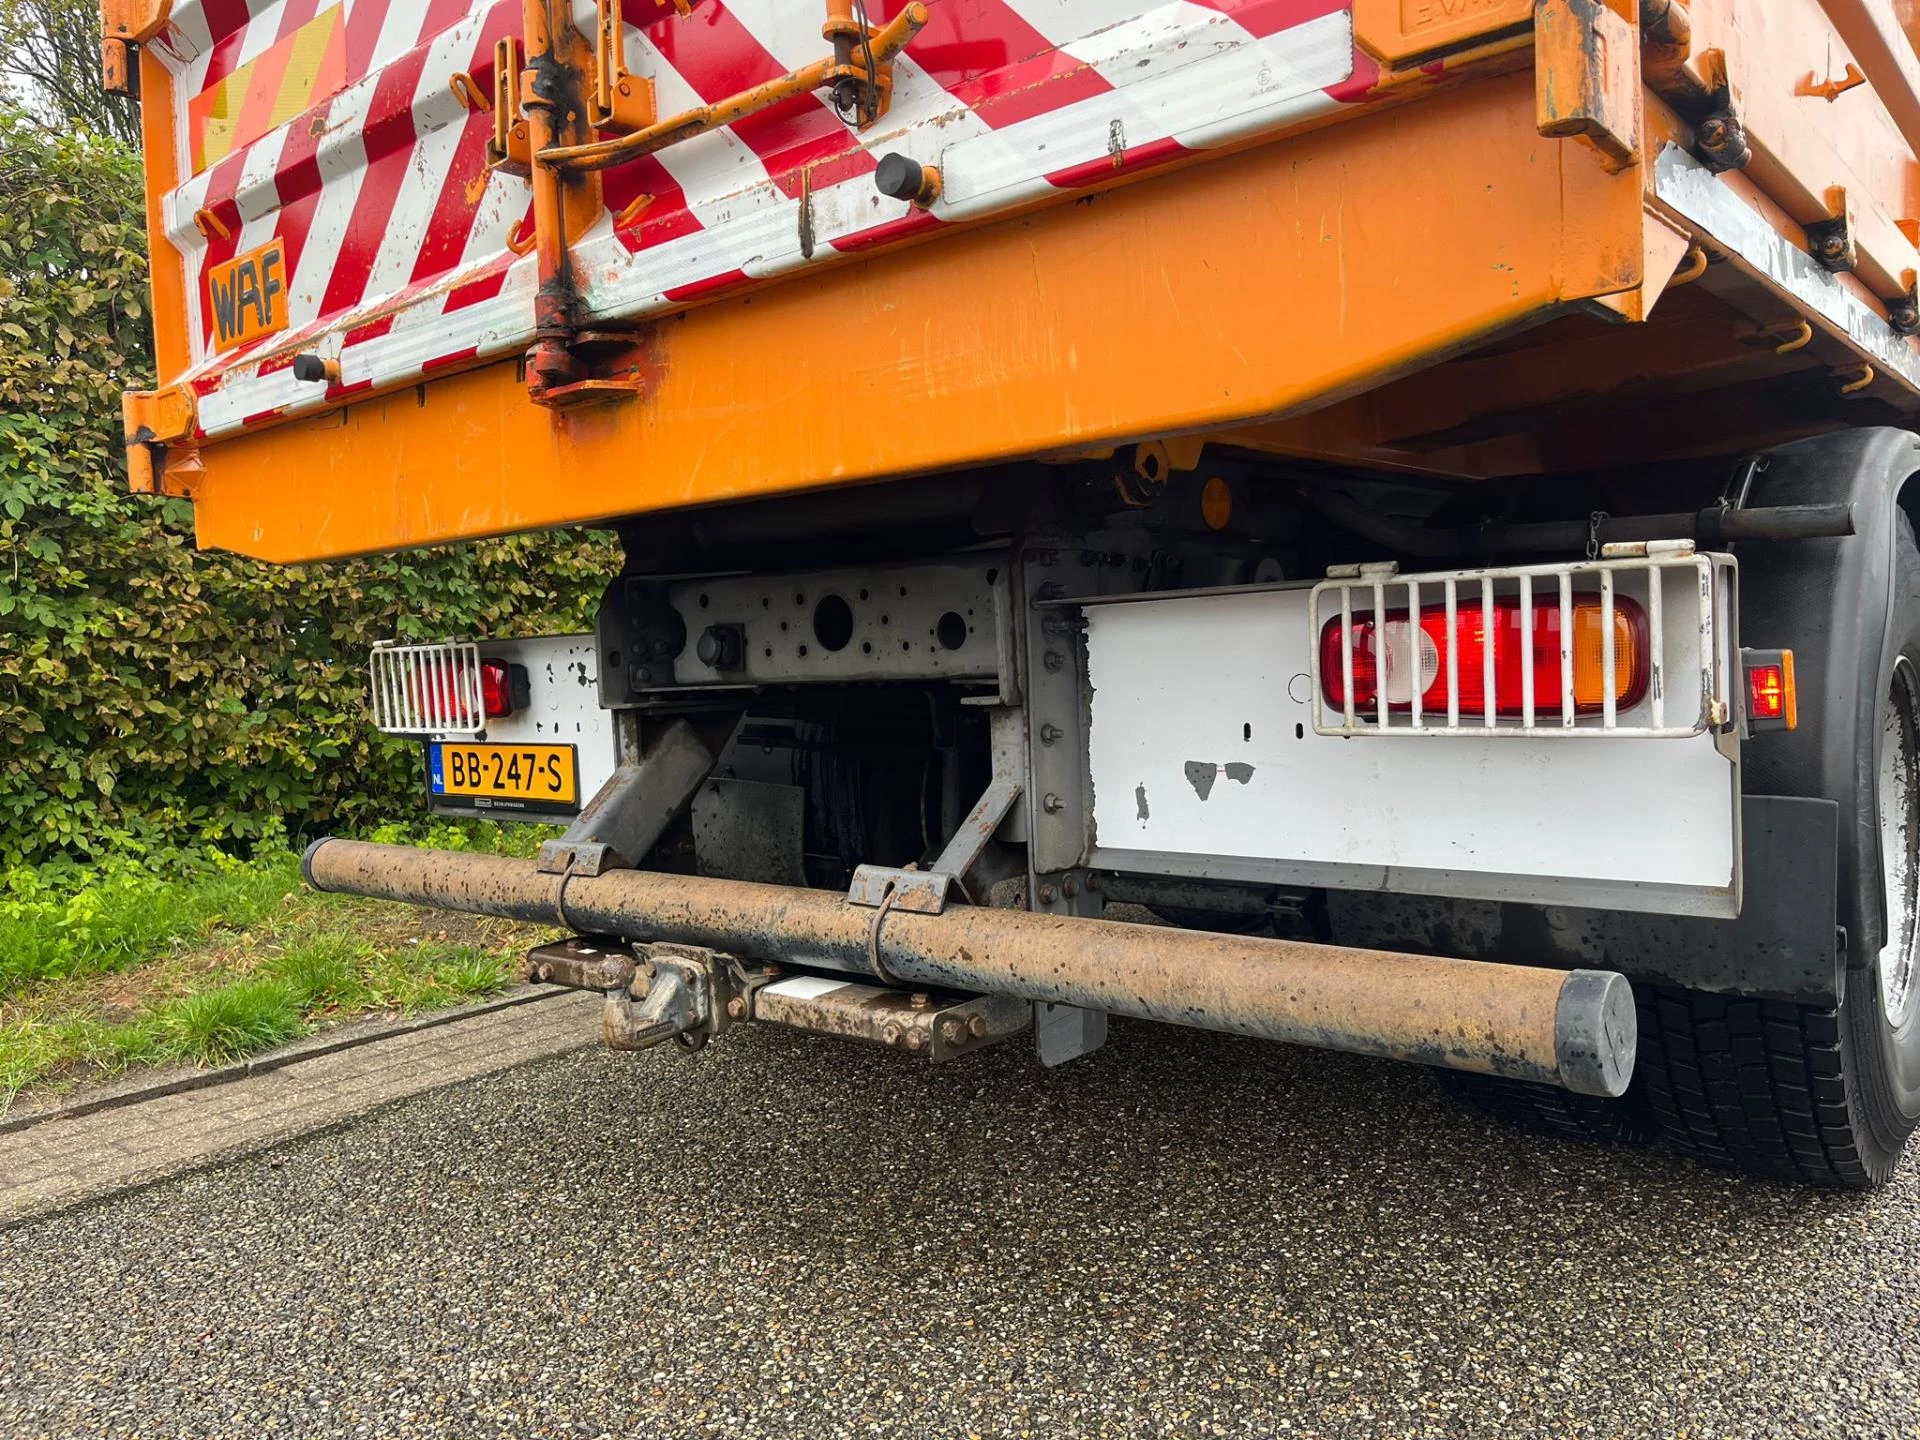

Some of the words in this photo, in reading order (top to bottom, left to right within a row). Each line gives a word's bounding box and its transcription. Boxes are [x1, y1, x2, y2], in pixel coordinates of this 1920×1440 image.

[211, 249, 280, 343] WAF
[433, 773, 443, 785] NL
[451, 751, 562, 793] BB-247-S
